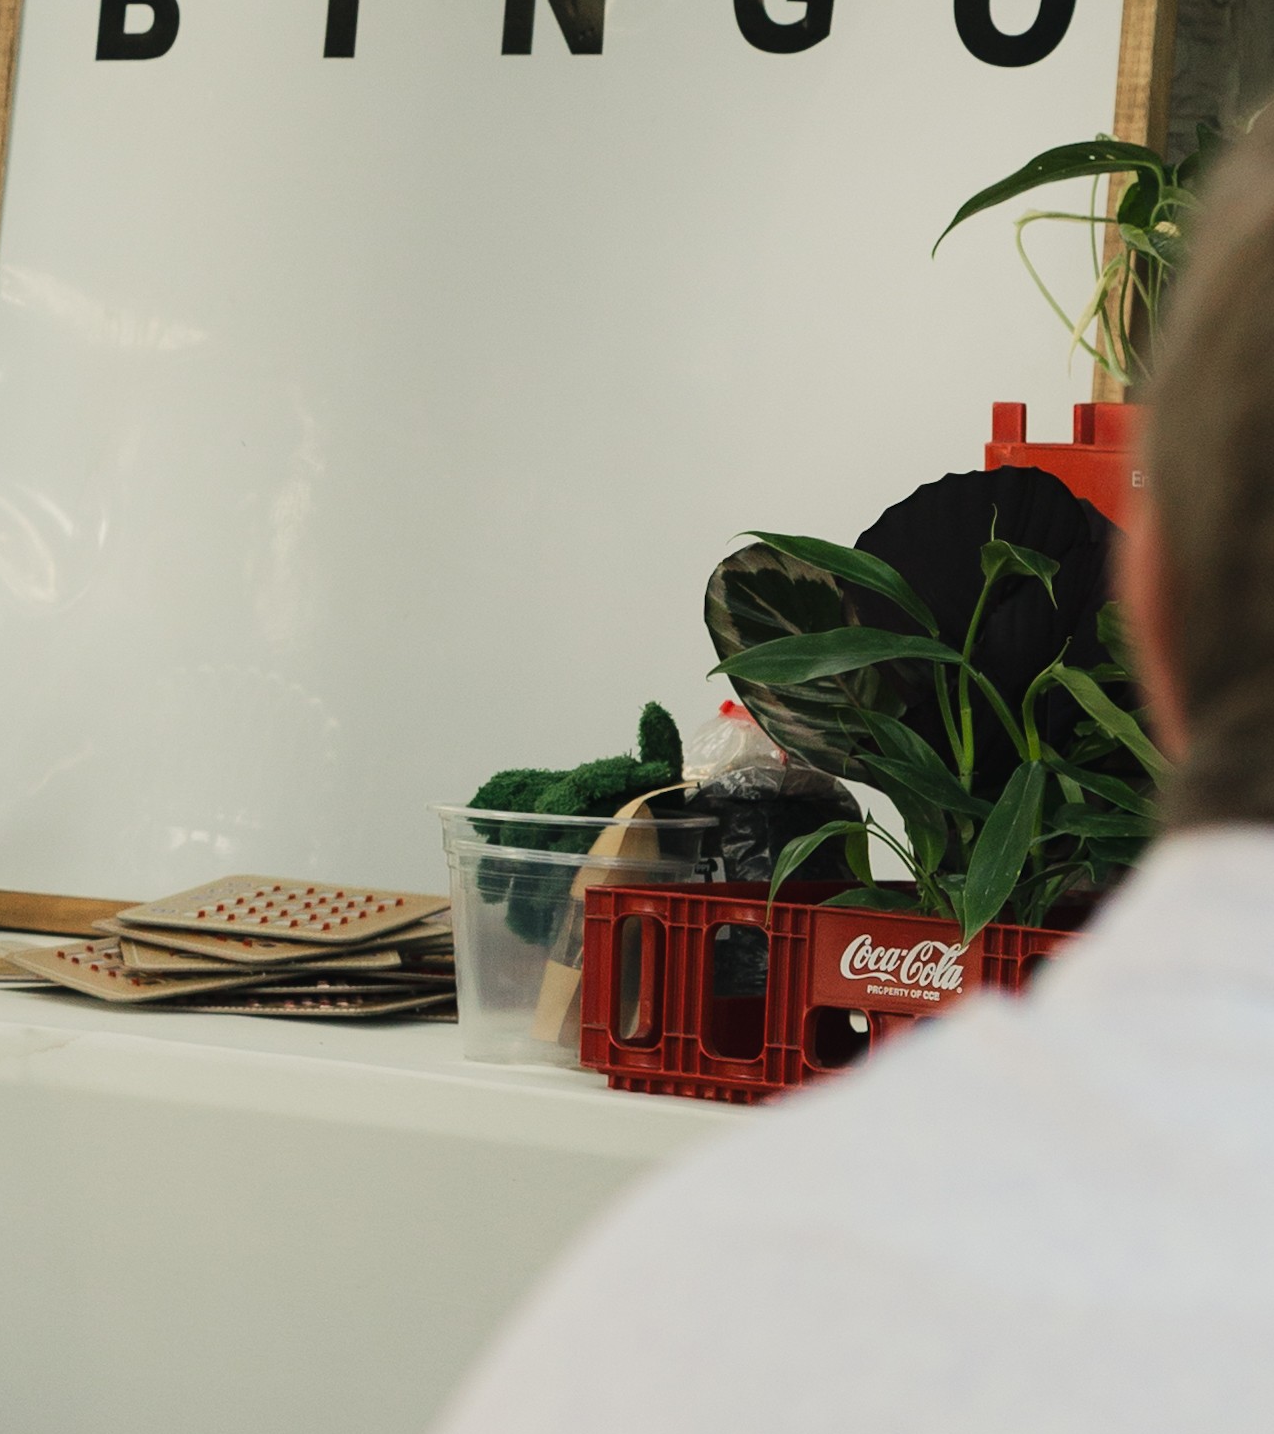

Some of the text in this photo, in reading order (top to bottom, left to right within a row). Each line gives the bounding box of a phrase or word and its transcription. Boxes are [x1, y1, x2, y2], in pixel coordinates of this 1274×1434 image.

[840, 934, 969, 990] Coca-Cola
[867, 984, 909, 997] PROPERTY
[910, 989, 923, 999] OF
